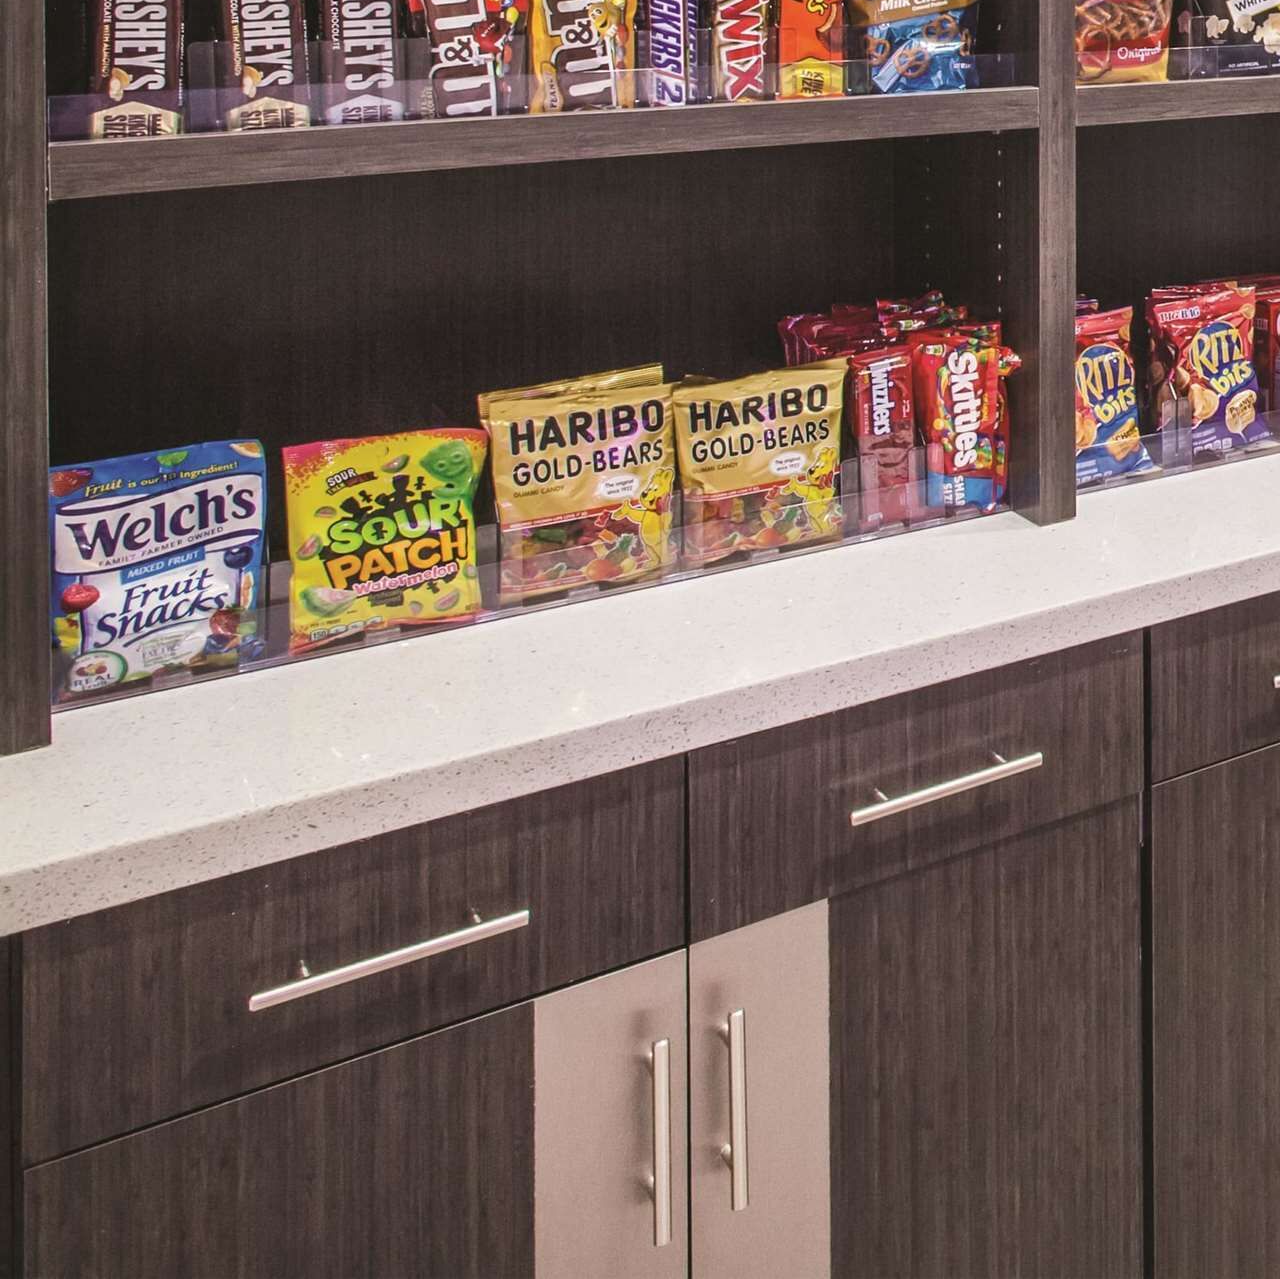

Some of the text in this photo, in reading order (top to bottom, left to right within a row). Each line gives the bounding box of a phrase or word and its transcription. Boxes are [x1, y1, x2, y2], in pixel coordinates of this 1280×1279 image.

[103, 24, 111, 42] WITH
[230, 24, 241, 42] WITH
[331, 7, 341, 51] CHOCOLATE
[101, 43, 110, 78] ALMONDS
[232, 42, 243, 77] ALMONDS
[1159, 306, 1201, 322] BIG BAG
[1191, 328, 1244, 375] RITZ
[1078, 351, 1132, 402] RITZ
[1209, 360, 1253, 397] bits
[689, 383, 829, 434] HARIBO
[866, 358, 895, 437] Twizzlers
[949, 350, 982, 469] Skittles
[1095, 386, 1137, 424] bits
[510, 399, 664, 456] HARIBO
[692, 419, 830, 463] GOLD-BEARS
[85, 461, 239, 498] Fruit is our Ingredient!
[327, 468, 357, 488] SOUR
[512, 439, 663, 487] GOLD-BEARS
[716, 461, 739, 472] CANDY
[540, 484, 566, 496] CANDY
[65, 484, 256, 560] Welch's
[330, 499, 461, 554] SOUR
[99, 526, 223, 567] FAMILY FARMER OWNED
[127, 551, 201, 579] MIXED FRUIT
[326, 527, 467, 590] PATCH
[120, 567, 214, 616] Fruit
[352, 561, 459, 597] Watermelon
[94, 590, 229, 649] Snacks
[73, 673, 114, 688] REAL
